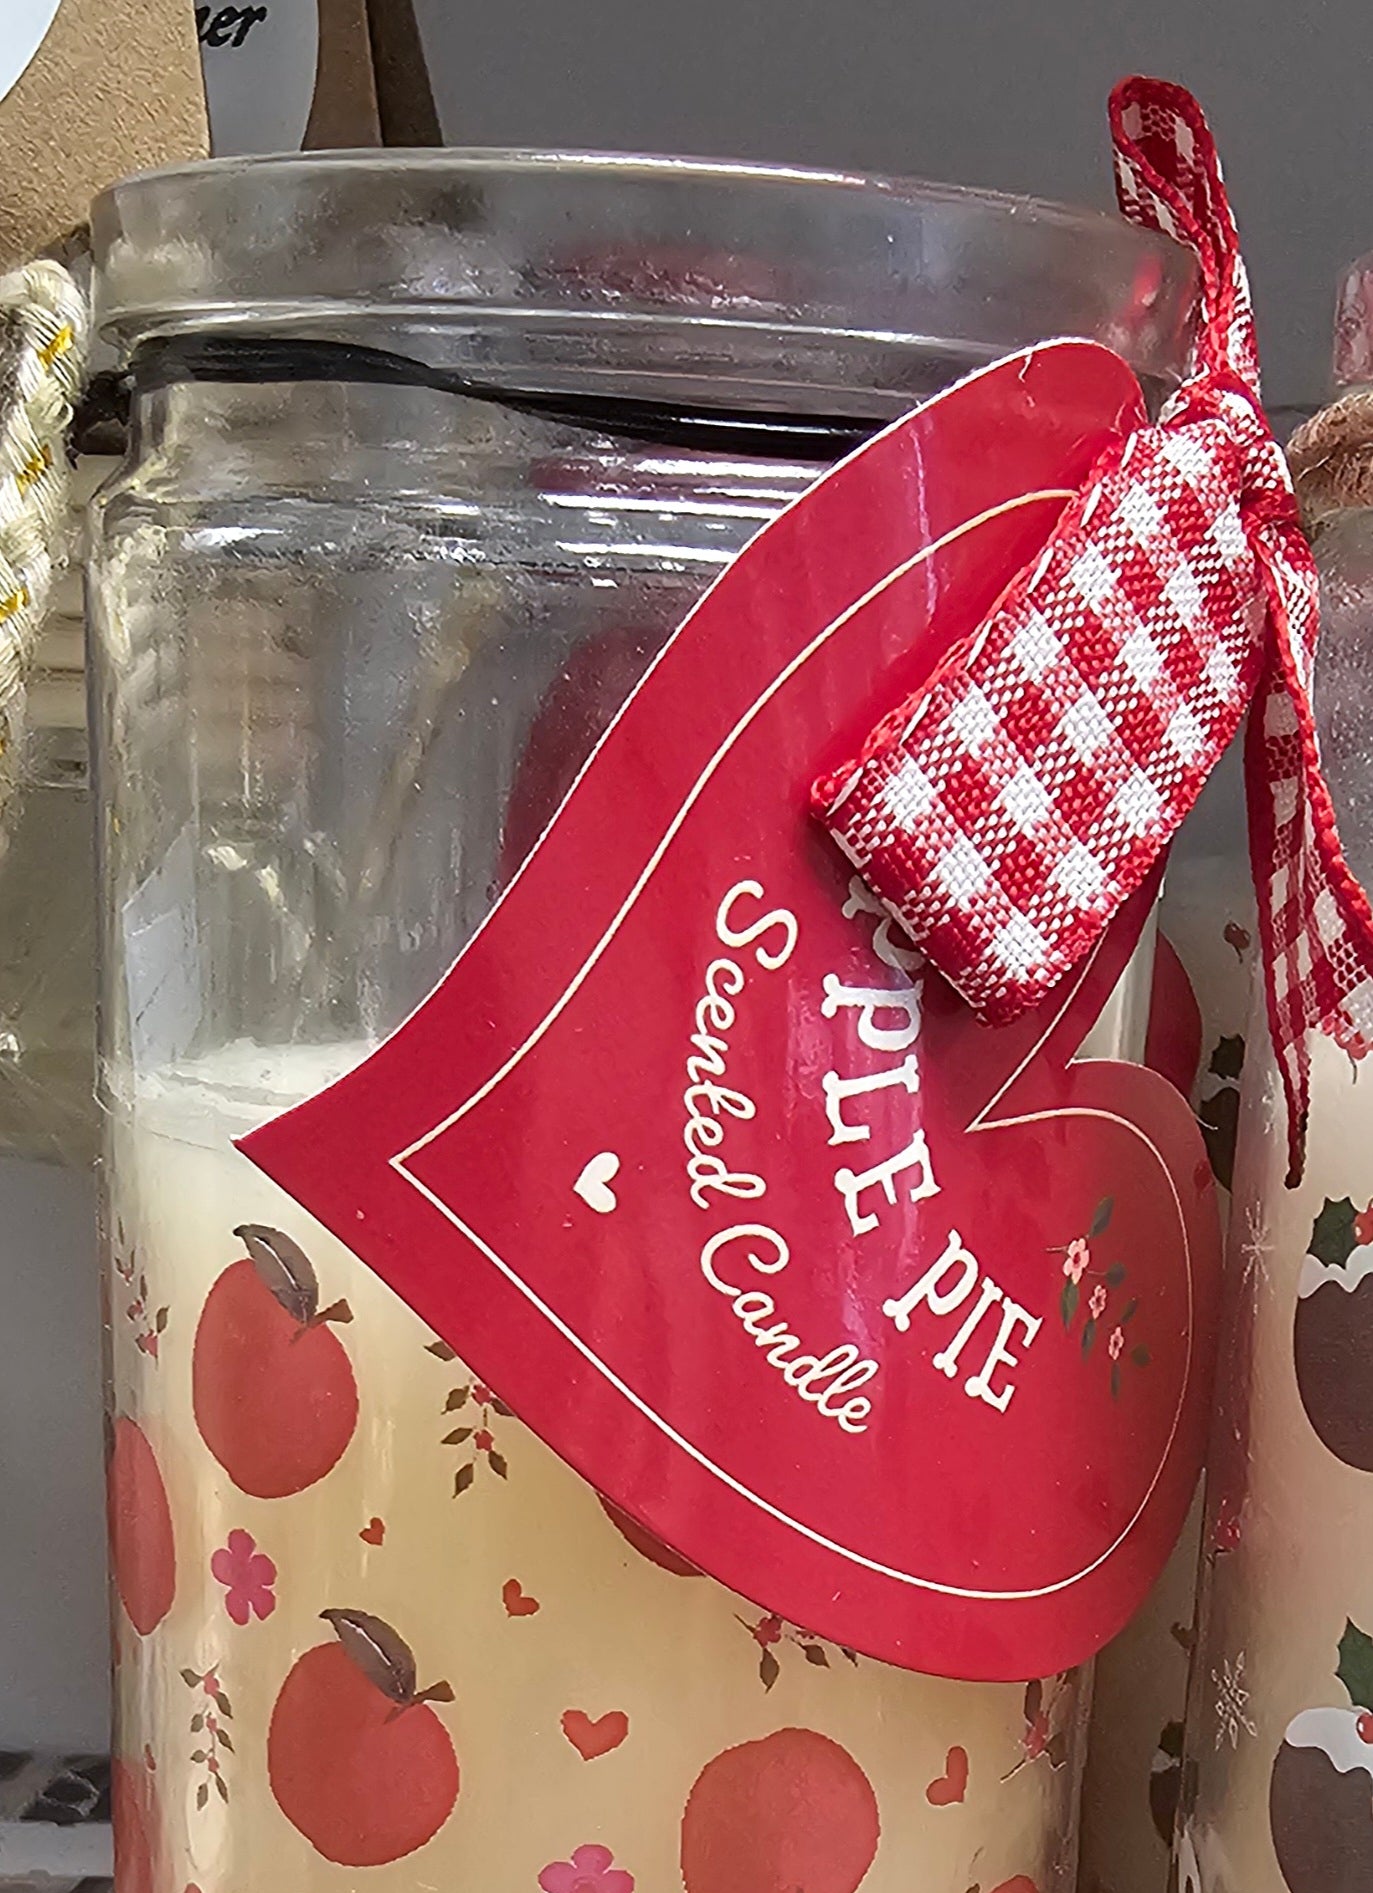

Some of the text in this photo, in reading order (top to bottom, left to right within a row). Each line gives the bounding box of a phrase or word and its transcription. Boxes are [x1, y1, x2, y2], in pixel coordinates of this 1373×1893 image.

[683, 880, 878, 1434] Scented Candle
[882, 1229, 1044, 1414] PIE
